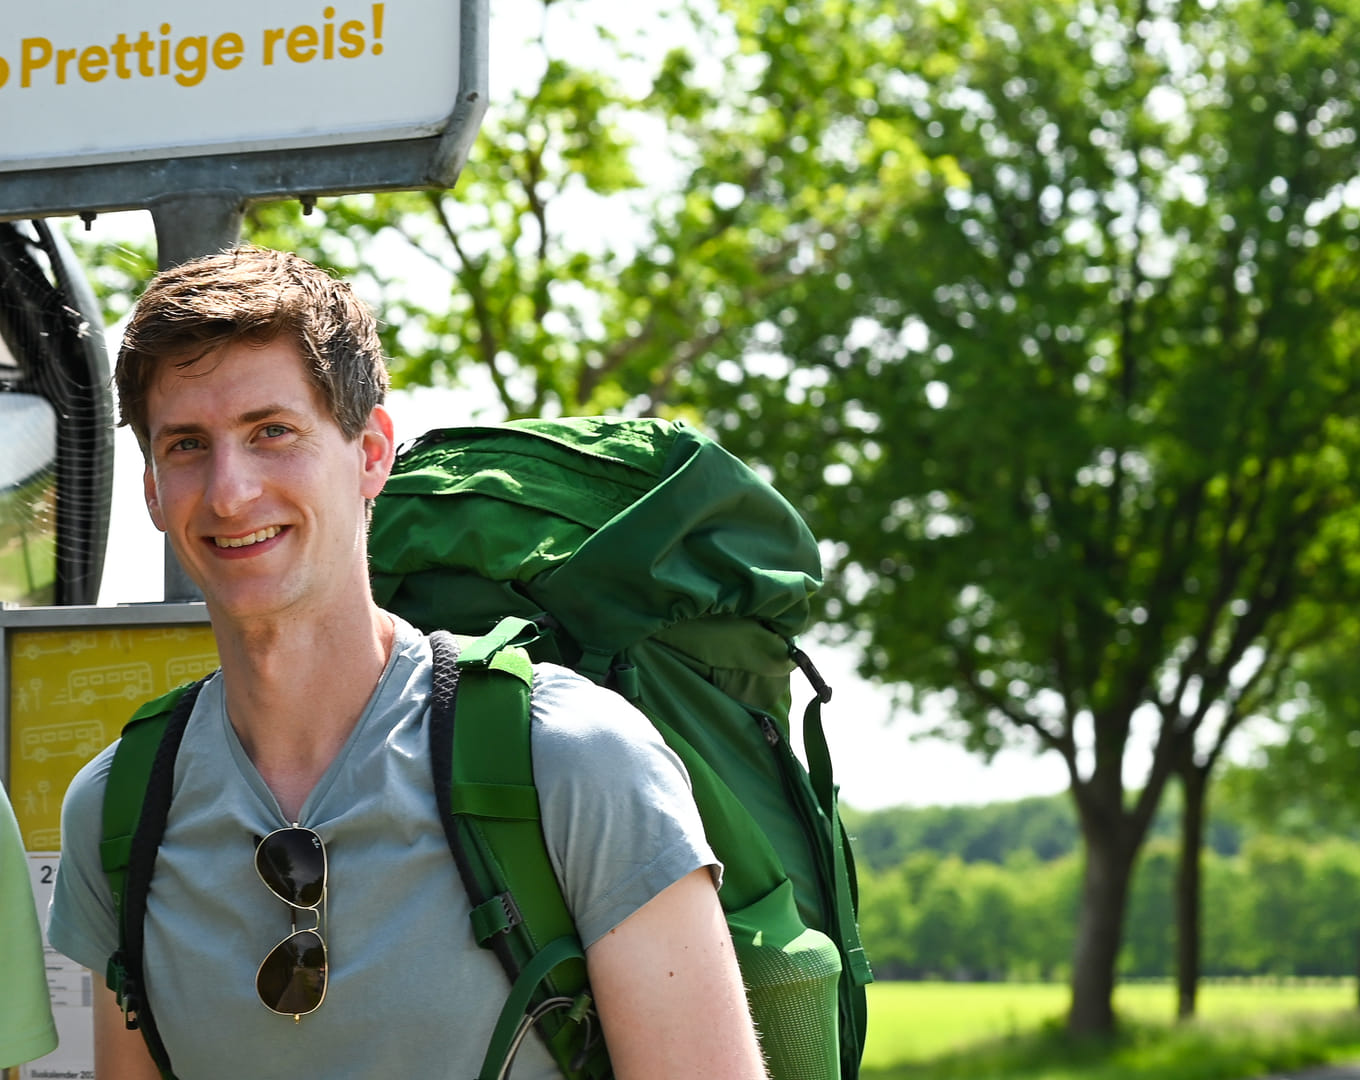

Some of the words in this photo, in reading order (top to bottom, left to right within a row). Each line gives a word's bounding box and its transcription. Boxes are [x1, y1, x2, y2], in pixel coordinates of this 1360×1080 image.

[19, 23, 244, 88] Prettige
[263, 3, 386, 66] reis!
[40, 865, 56, 884] 2
